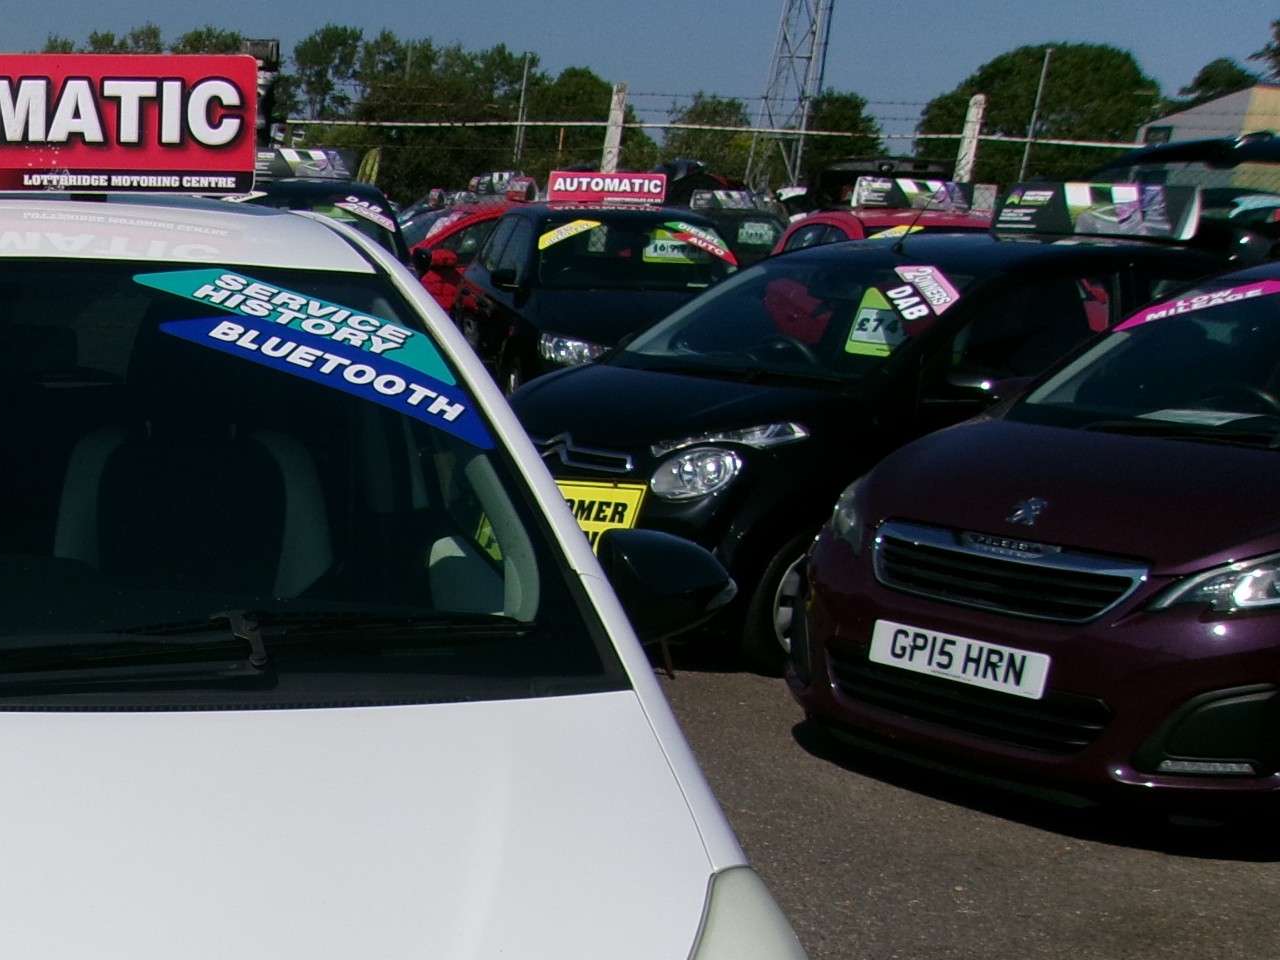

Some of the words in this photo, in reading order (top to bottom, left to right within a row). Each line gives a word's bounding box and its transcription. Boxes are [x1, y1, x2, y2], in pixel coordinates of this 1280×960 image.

[23, 174, 108, 187] LOTTBRIDGE
[111, 175, 180, 187] MOTORING
[182, 177, 236, 188] CENTRE
[553, 177, 662, 193] AUTOMATIC
[687, 237, 725, 256] AUTO
[214, 274, 414, 344] SERVICE
[886, 285, 930, 320] DAB
[1145, 289, 1263, 321] MILEAGE
[1176, 289, 1233, 307] LOW
[193, 285, 402, 354] HISTORY
[208, 321, 466, 421] BLUETOOTH
[890, 628, 956, 670] GP15
[961, 643, 1027, 687] HRN
